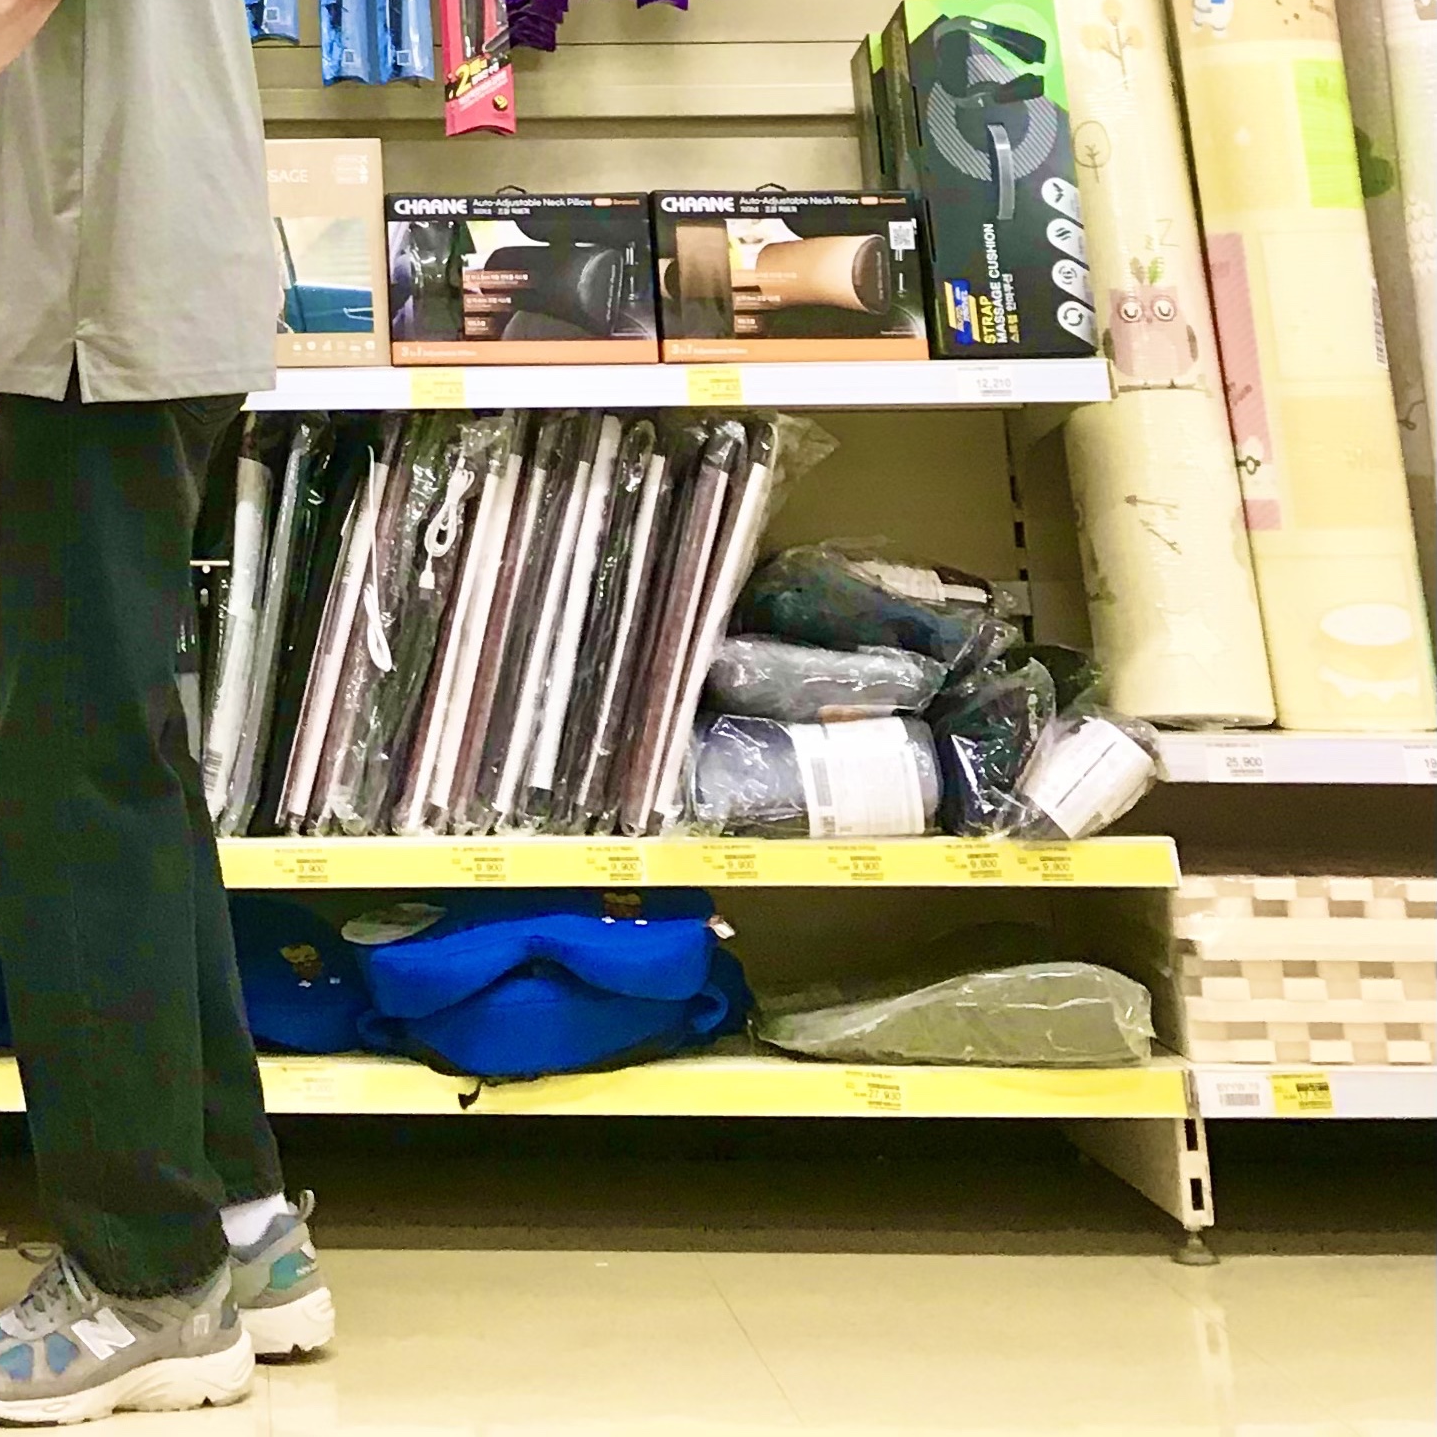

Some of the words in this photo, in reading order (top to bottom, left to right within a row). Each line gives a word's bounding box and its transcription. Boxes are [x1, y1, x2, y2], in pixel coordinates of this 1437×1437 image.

[472, 198, 542, 209] Auto-Adjustable
[543, 198, 566, 208] Neck
[567, 197, 593, 208] Pillow
[739, 196, 809, 207] Auto-Adjustable
[810, 196, 833, 205] Neck
[834, 196, 859, 206] Pillow
[983, 222, 1004, 282] CUSHION
[992, 282, 1008, 345] MASSAGE
[1004, 272, 1019, 311] 안마쿠션
[980, 294, 998, 344] STRAP
[72, 1306, 136, 1361] N
